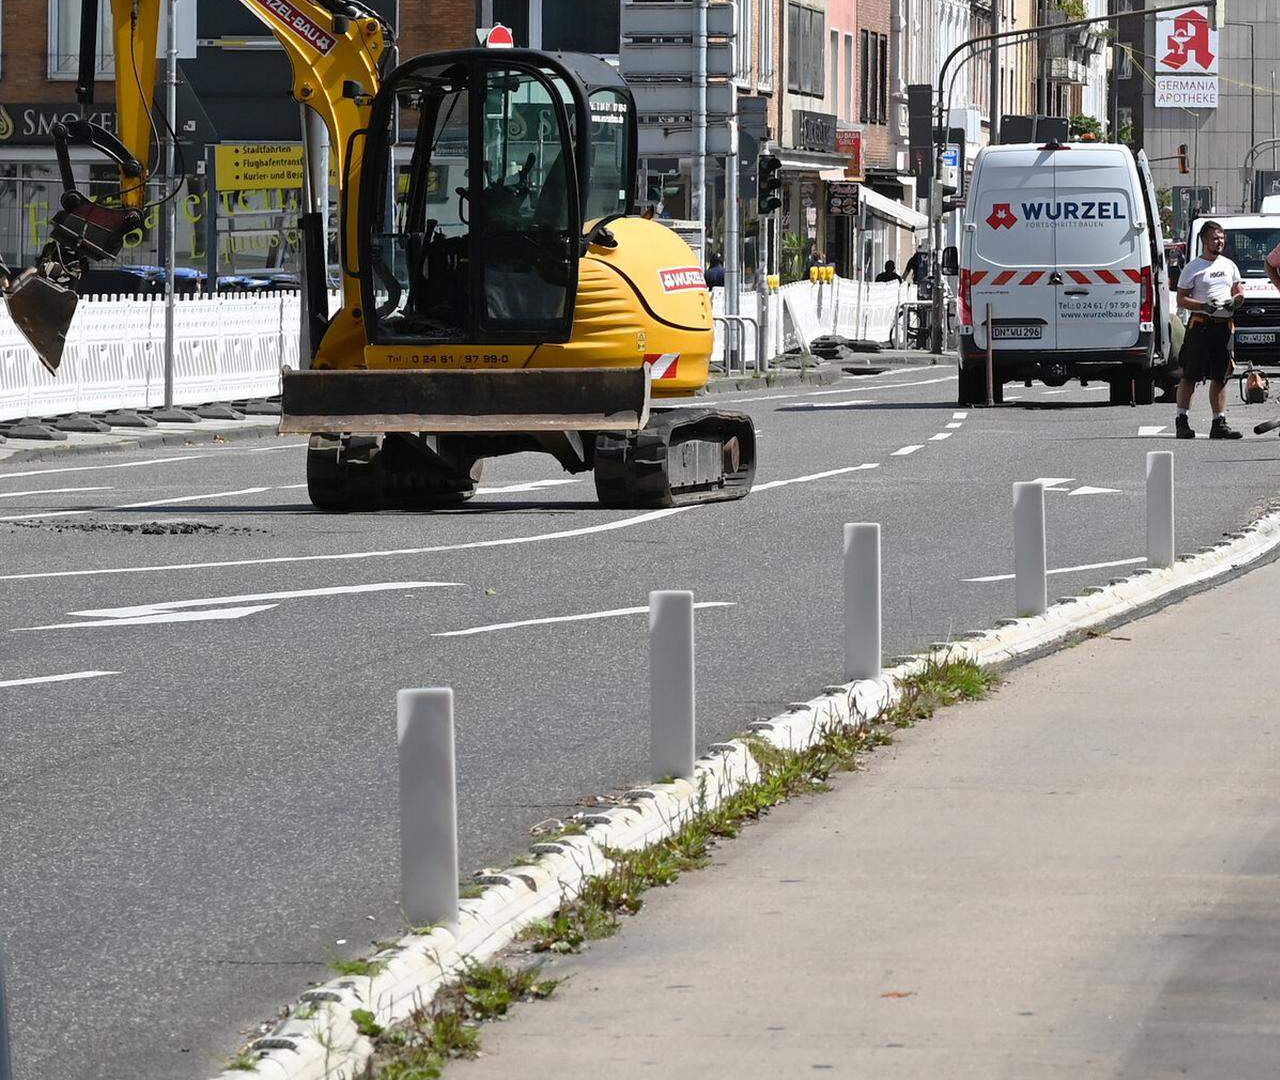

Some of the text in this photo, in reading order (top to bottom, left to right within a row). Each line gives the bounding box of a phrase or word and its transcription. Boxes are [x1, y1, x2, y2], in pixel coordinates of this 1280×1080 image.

[1158, 80, 1217, 91] GERMANIA
[1158, 93, 1217, 103] APOTHEKE
[242, 145, 292, 155] Stadtfahrten
[1021, 202, 1126, 220] WURZEL
[1058, 301, 1076, 310] Tel.:
[1076, 301, 1082, 310] 0
[1082, 301, 1093, 310] 24
[1093, 301, 1103, 310] 61
[1110, 301, 1119, 310] 97
[1060, 310, 1135, 320] www.wurzelbau.de
[993, 327, 1007, 337] DN
[1023, 326, 1041, 337] 296
[411, 354, 419, 363] 0
[423, 354, 437, 363] 24
